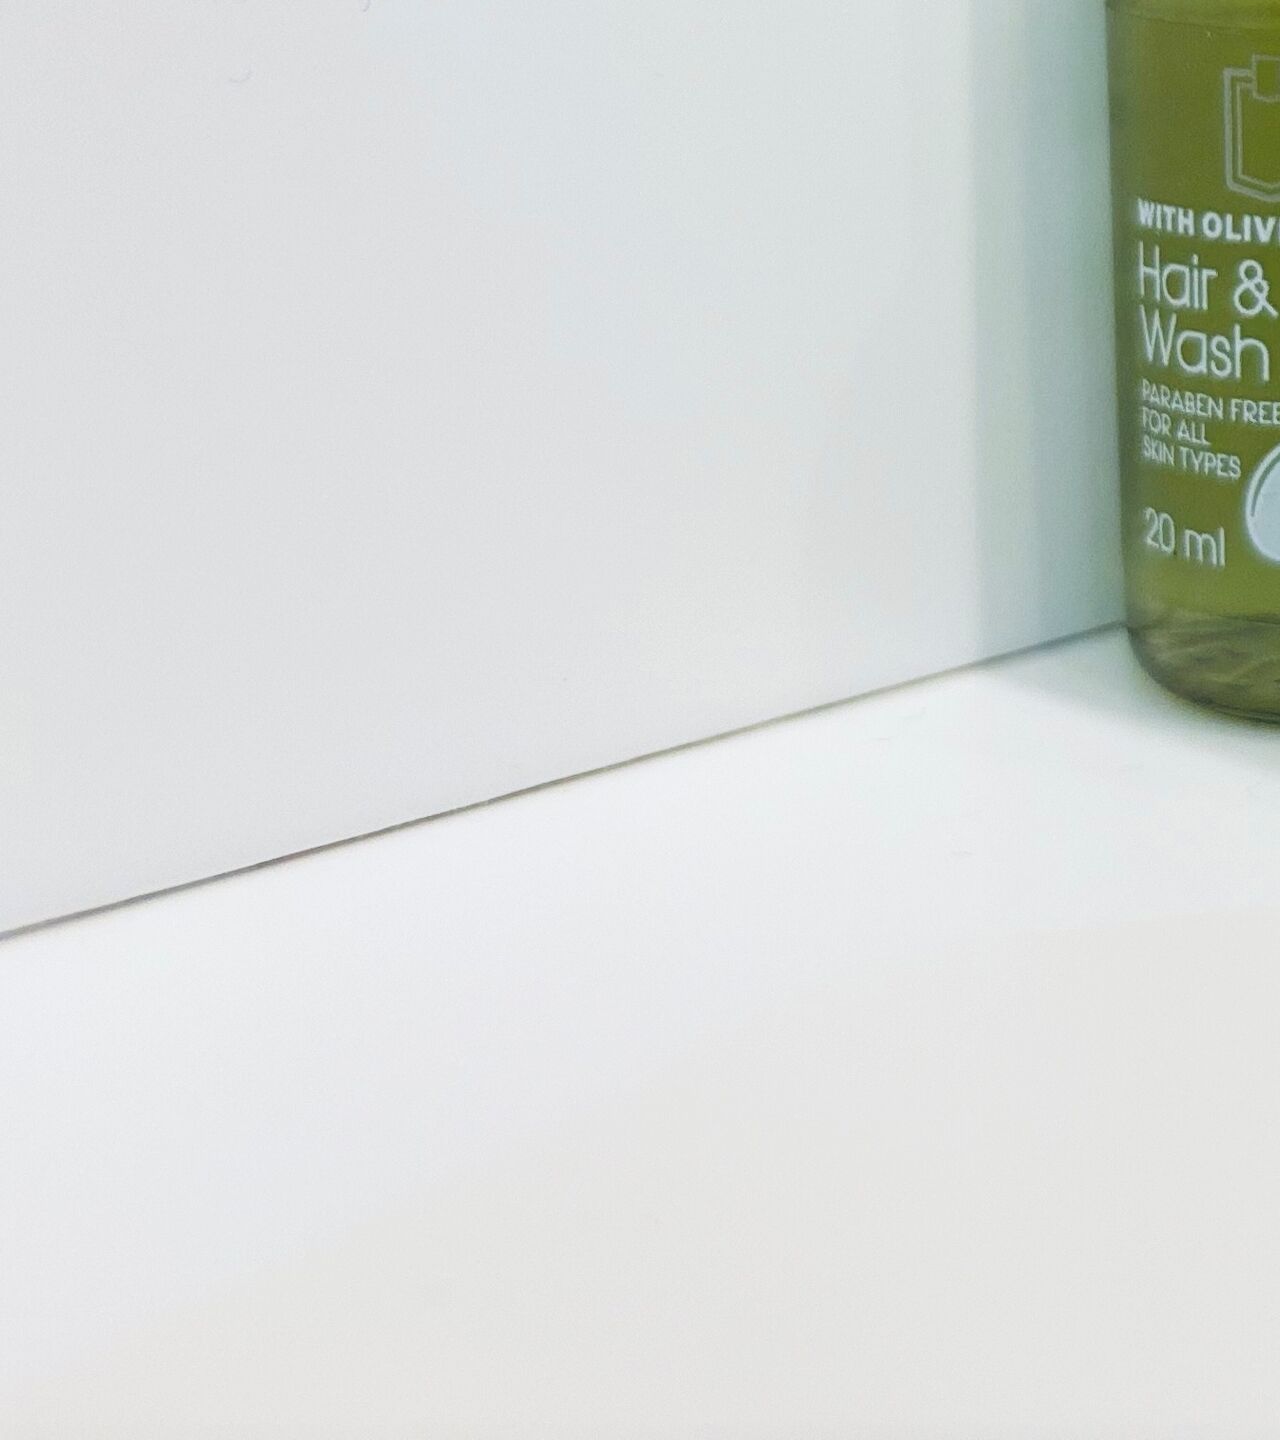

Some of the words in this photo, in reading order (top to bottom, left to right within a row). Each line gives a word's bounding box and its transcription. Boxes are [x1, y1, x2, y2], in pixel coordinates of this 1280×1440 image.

[1137, 198, 1195, 237] WITH
[1138, 240, 1218, 311] Hair
[1232, 258, 1279, 320] &
[1139, 304, 1271, 383] Wash
[1141, 377, 1224, 421] PARABEN
[1142, 406, 1173, 437] FOR
[1177, 418, 1212, 447] ALL
[1142, 434, 1175, 467] SKIN
[1179, 446, 1242, 481] TYPES
[1143, 506, 1176, 554] 20
[1183, 525, 1226, 568] ml
